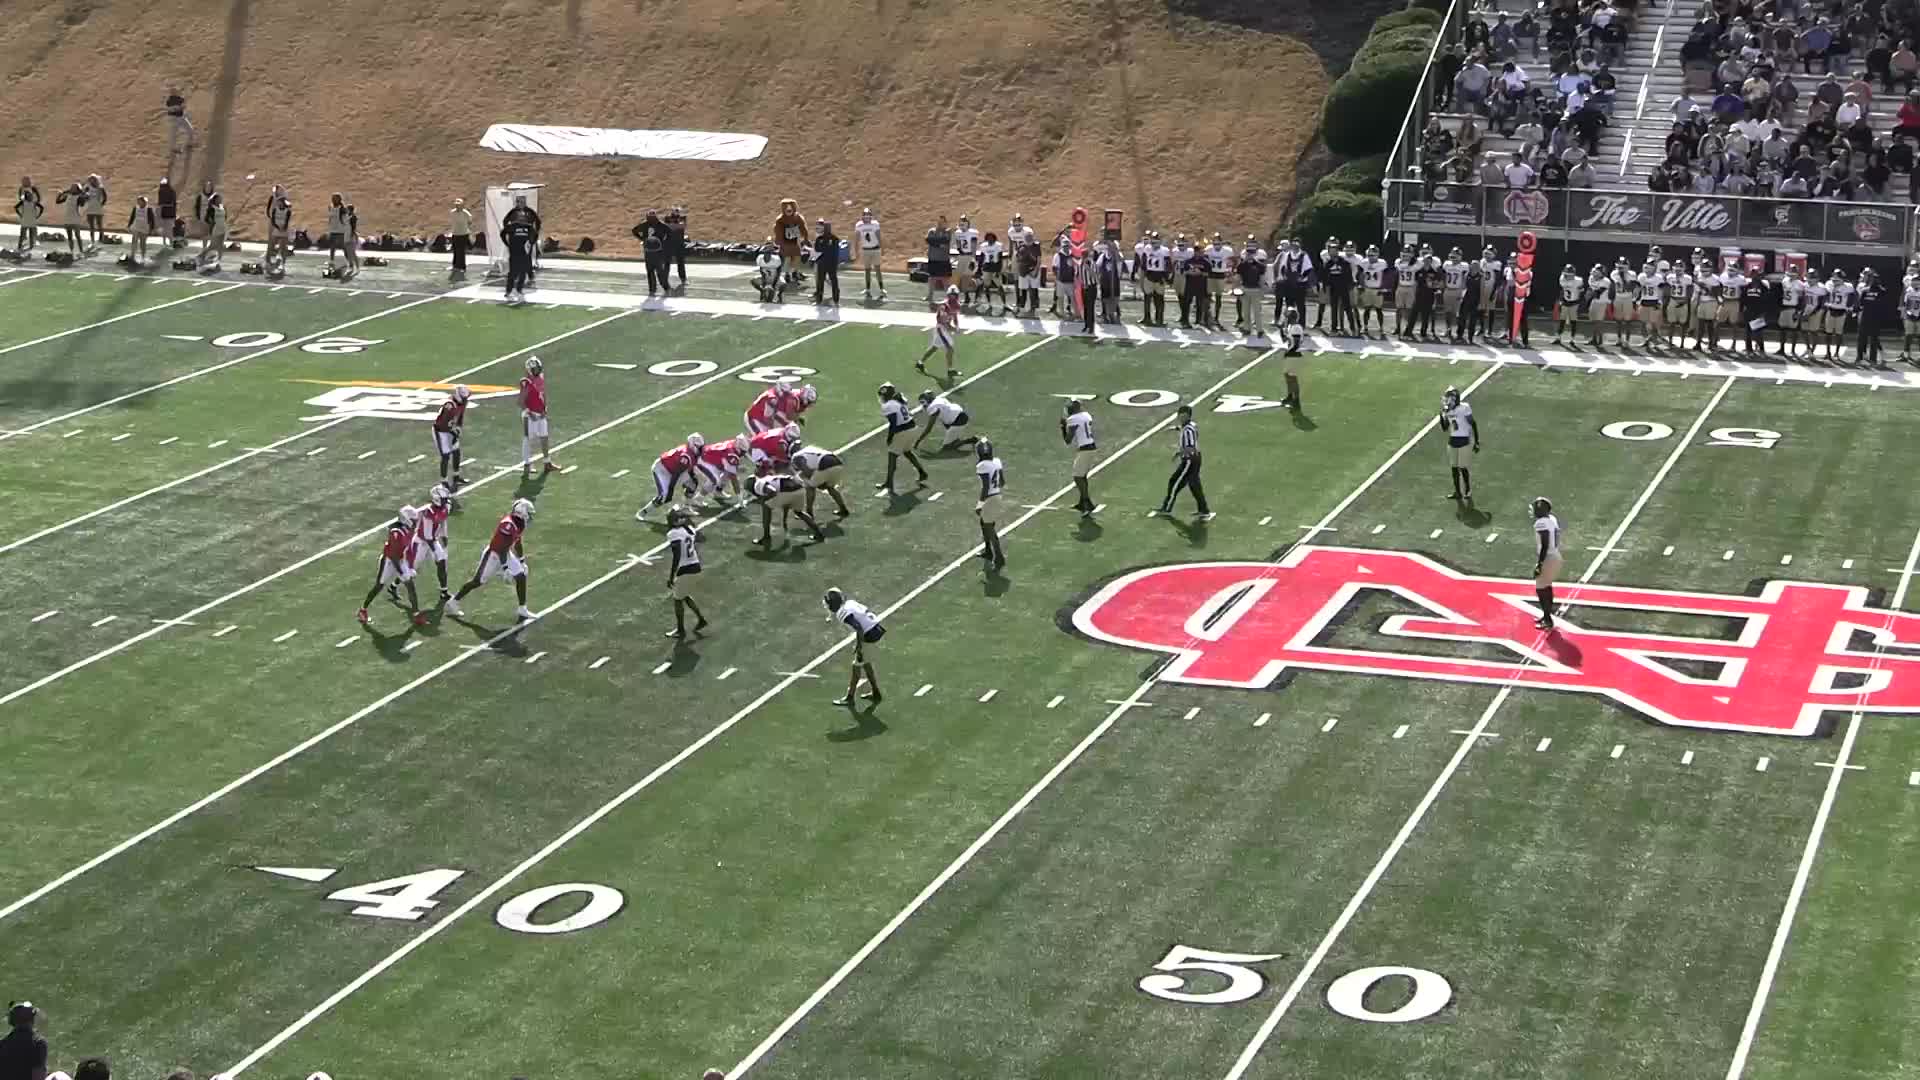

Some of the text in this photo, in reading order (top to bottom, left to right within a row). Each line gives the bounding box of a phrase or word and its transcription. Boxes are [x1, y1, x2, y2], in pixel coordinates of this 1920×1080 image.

[1579, 195, 1732, 232] The Ville
[1601, 420, 1783, 449] 50
[326, 868, 624, 933] 40
[1139, 944, 1452, 1022] 50
